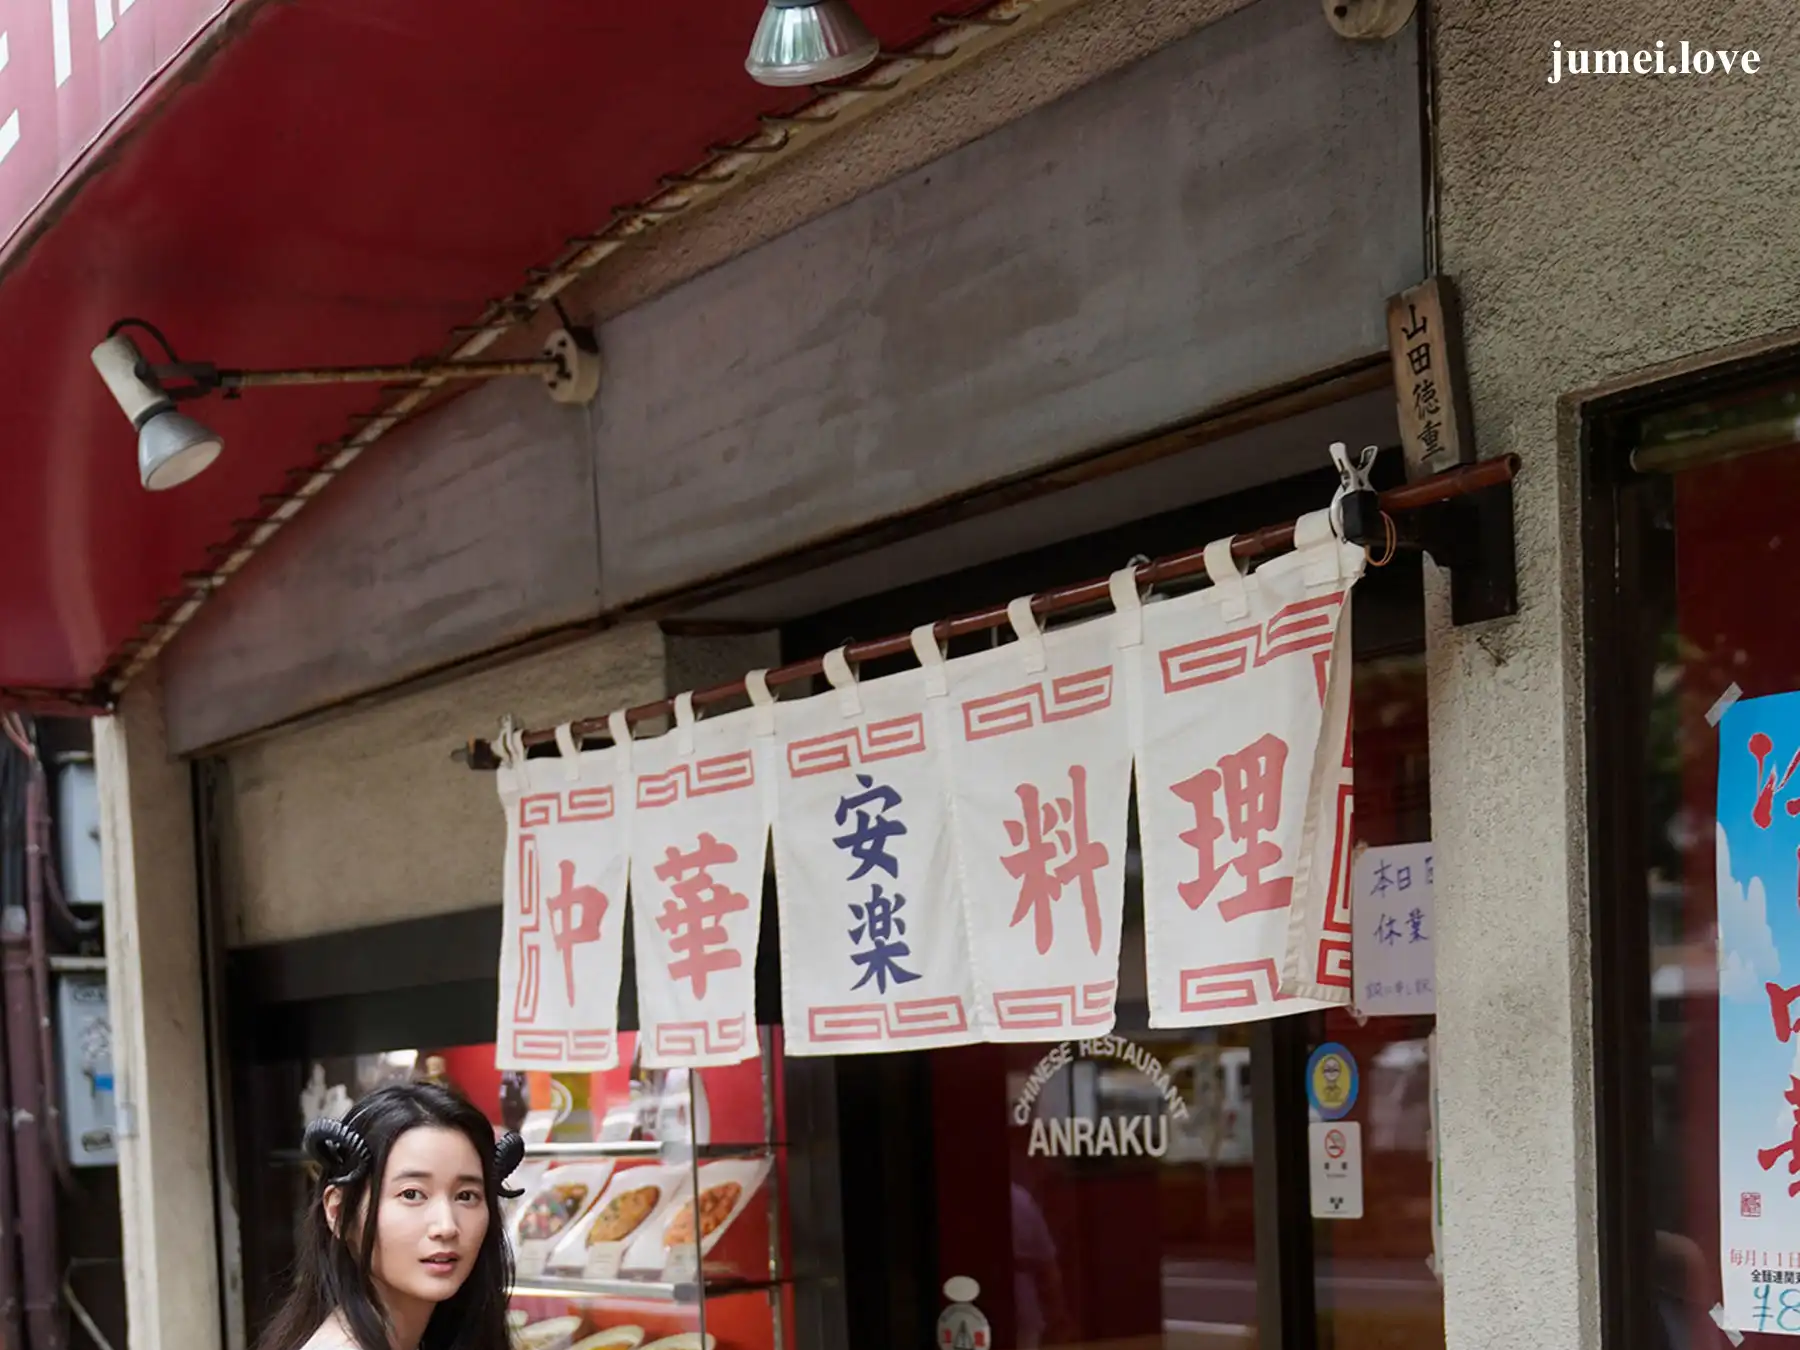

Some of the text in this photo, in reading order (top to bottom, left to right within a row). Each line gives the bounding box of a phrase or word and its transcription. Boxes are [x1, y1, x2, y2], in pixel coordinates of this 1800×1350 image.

[832, 774, 922, 995] 安楽
[1014, 1034, 1189, 1126] CHINESE RESTAURANT
[1027, 1114, 1169, 1157] ANRAKU
